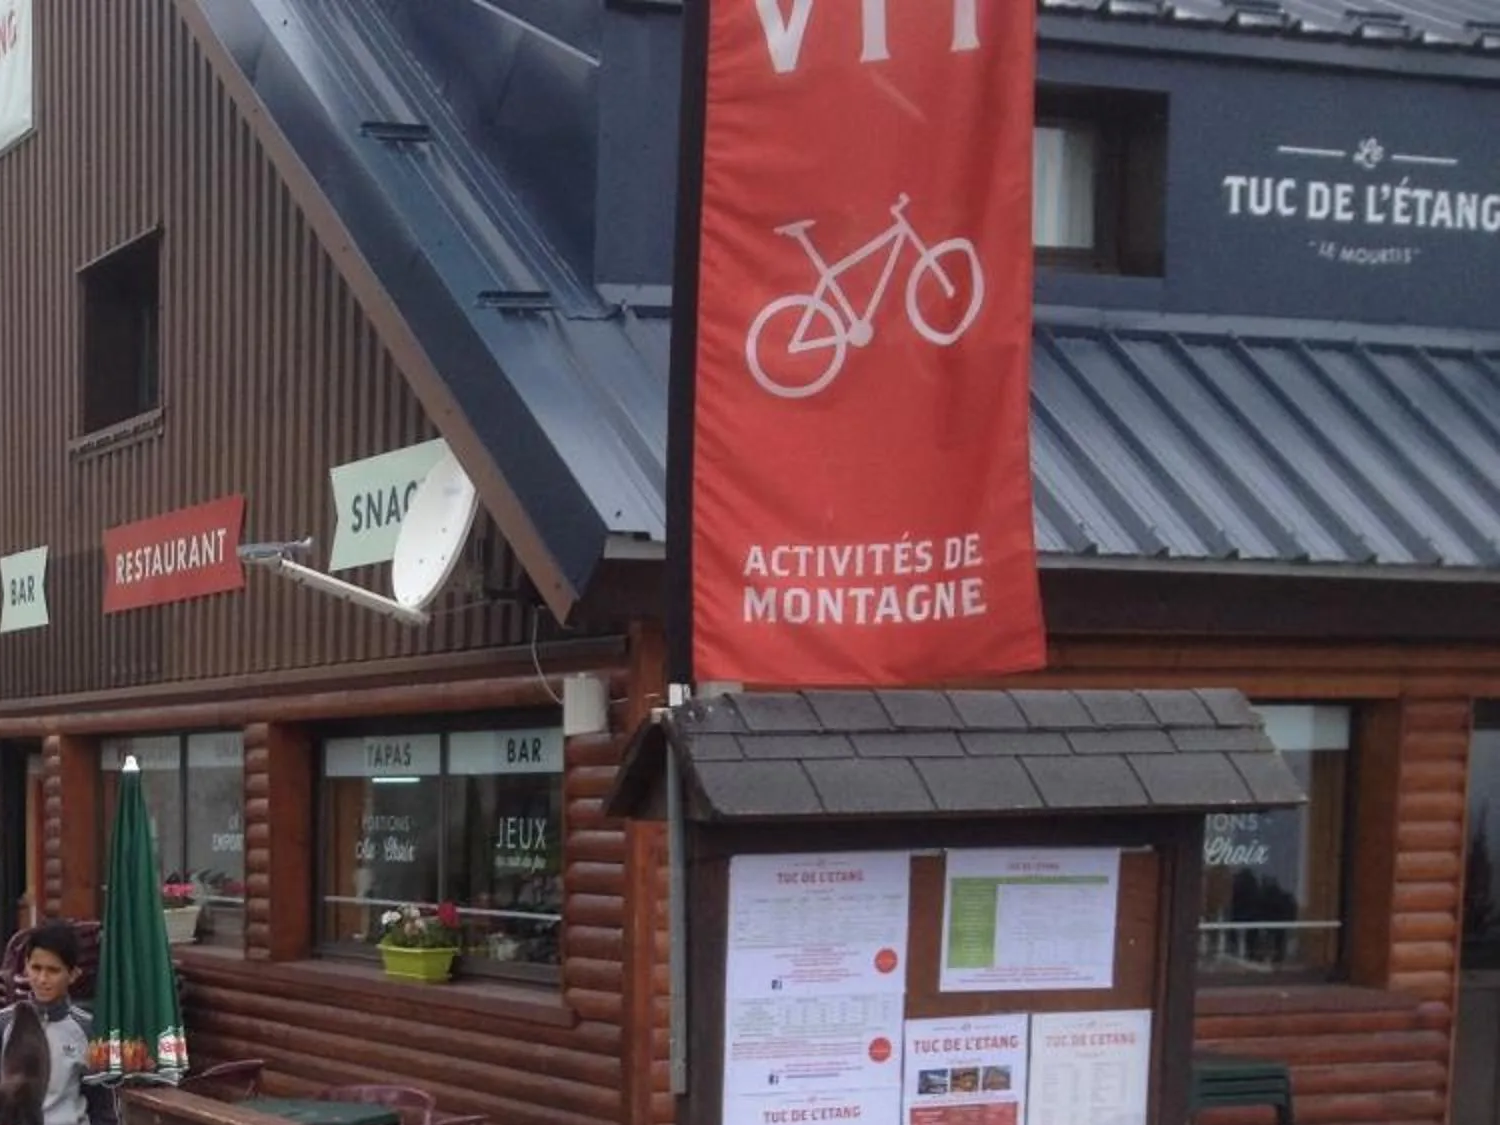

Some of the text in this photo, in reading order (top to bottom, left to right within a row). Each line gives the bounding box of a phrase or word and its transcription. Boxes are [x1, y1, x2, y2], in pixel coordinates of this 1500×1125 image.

[1222, 175, 1500, 233] TUC DE L'ÉTANG
[351, 479, 419, 534] SNAC
[115, 527, 228, 586] RESTAURANT
[743, 531, 983, 577] ACTIVITÉS DE
[9, 575, 35, 607] BAR
[743, 577, 988, 625] MONTAGNE
[366, 742, 412, 768] TAPAS
[506, 738, 543, 764] BAR
[496, 816, 548, 850] JEUX
